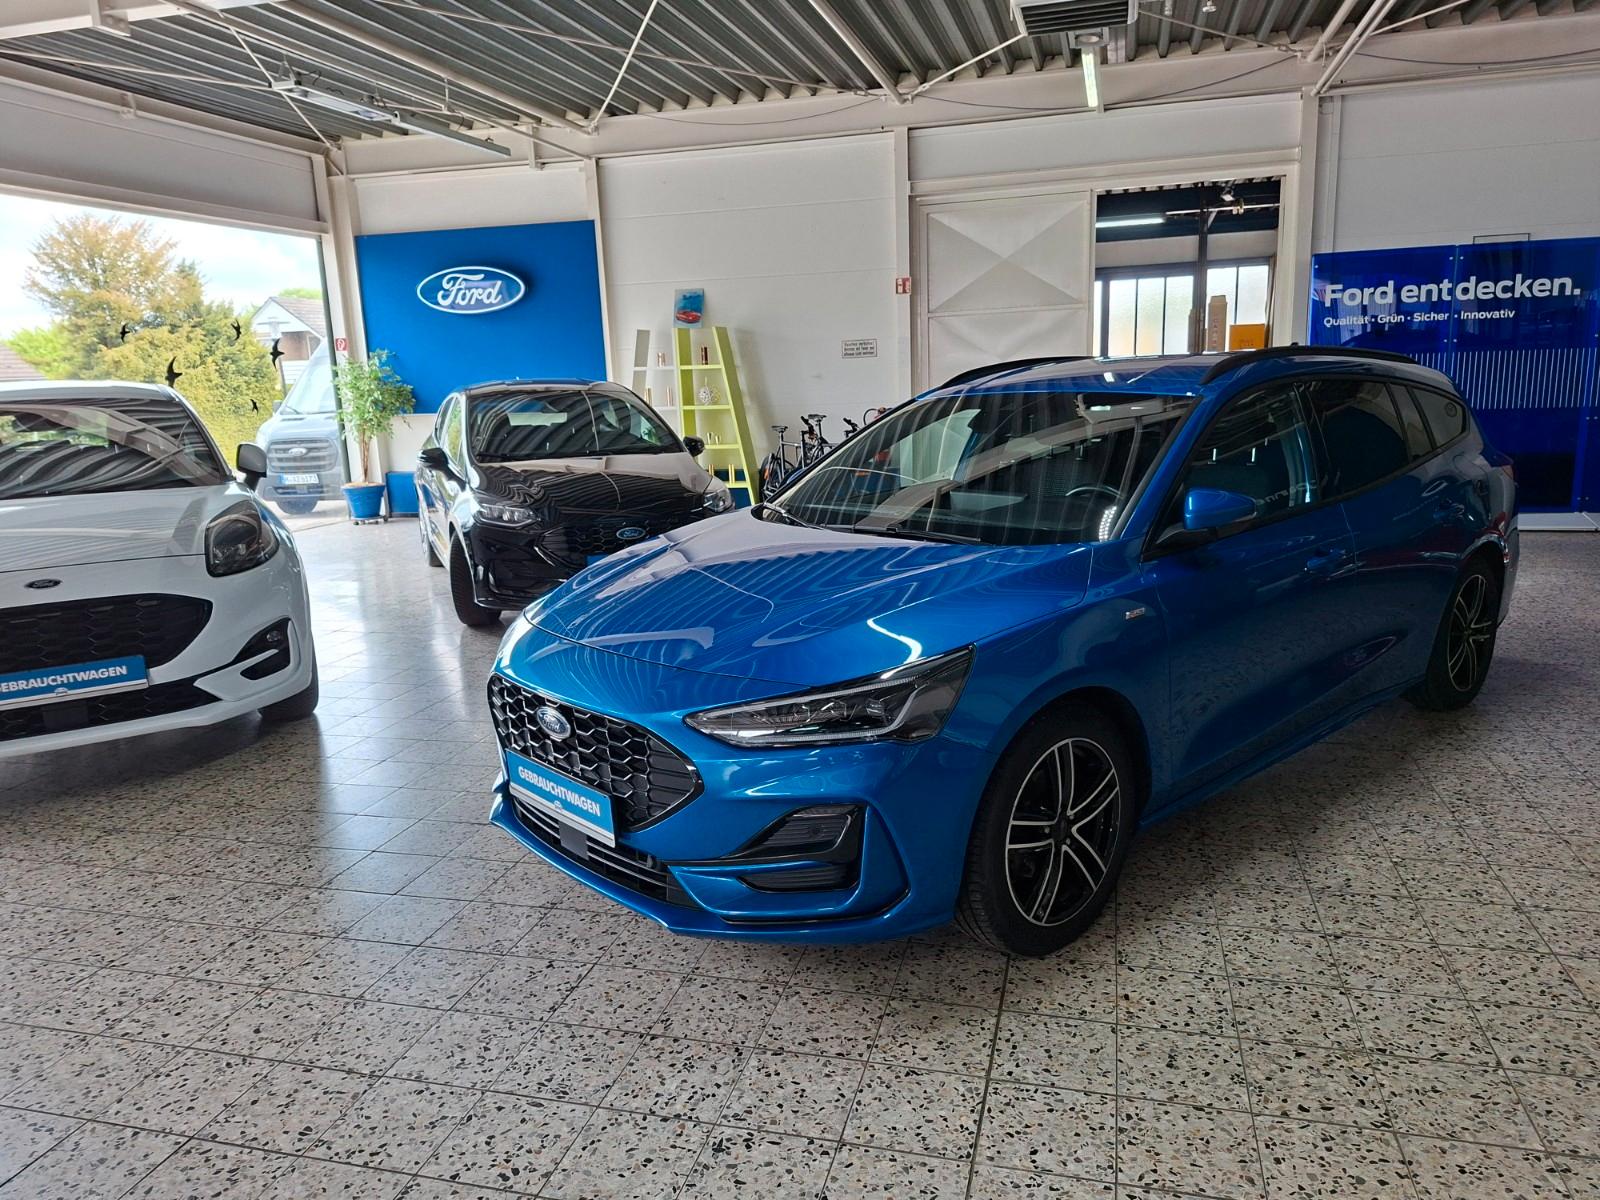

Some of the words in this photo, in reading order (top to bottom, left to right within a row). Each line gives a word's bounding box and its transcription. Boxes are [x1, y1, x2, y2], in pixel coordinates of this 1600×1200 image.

[437, 273, 502, 306] Ford
[1325, 280, 1394, 307] Ford
[1401, 274, 1581, 303] entdecken.
[1323, 315, 1369, 327] Qualität
[1377, 314, 1405, 324] Grün
[1413, 312, 1449, 322] Sicher
[1460, 309, 1516, 320] Innovativ
[0, 665, 128, 693] EBRAUCHTWAGEN
[518, 766, 601, 817] GEBRAUCHTWAGEN
